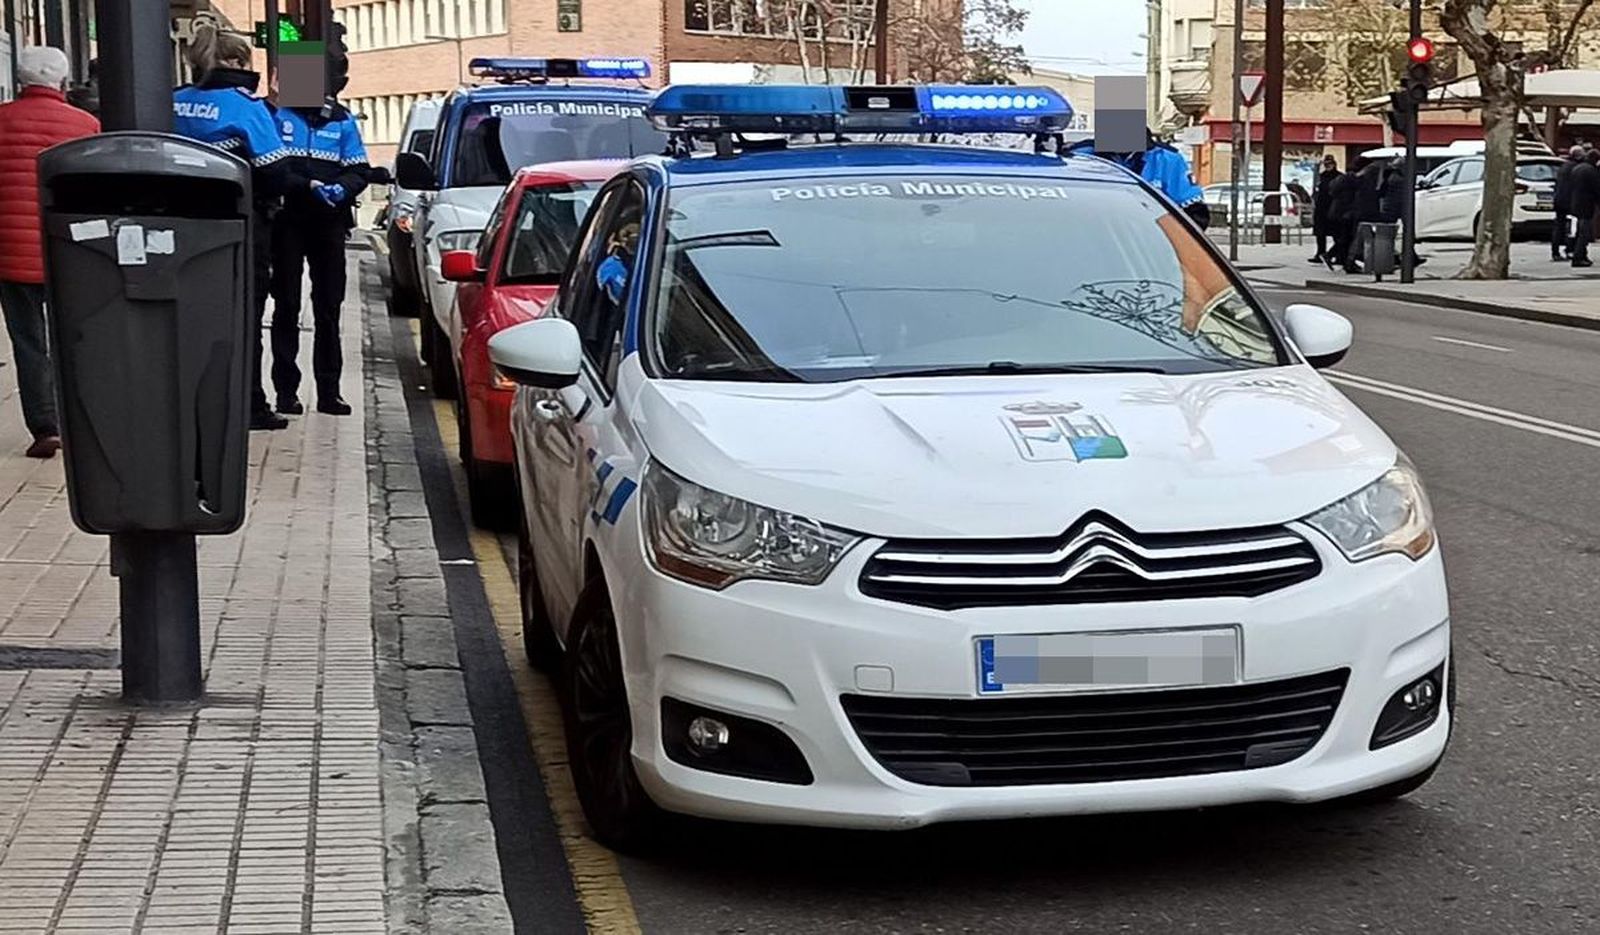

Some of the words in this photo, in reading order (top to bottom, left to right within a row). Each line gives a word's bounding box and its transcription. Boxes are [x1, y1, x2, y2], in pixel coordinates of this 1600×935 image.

[490, 102, 553, 117] Policía
[771, 183, 890, 201] Policía
[900, 180, 1068, 201] Municipal
